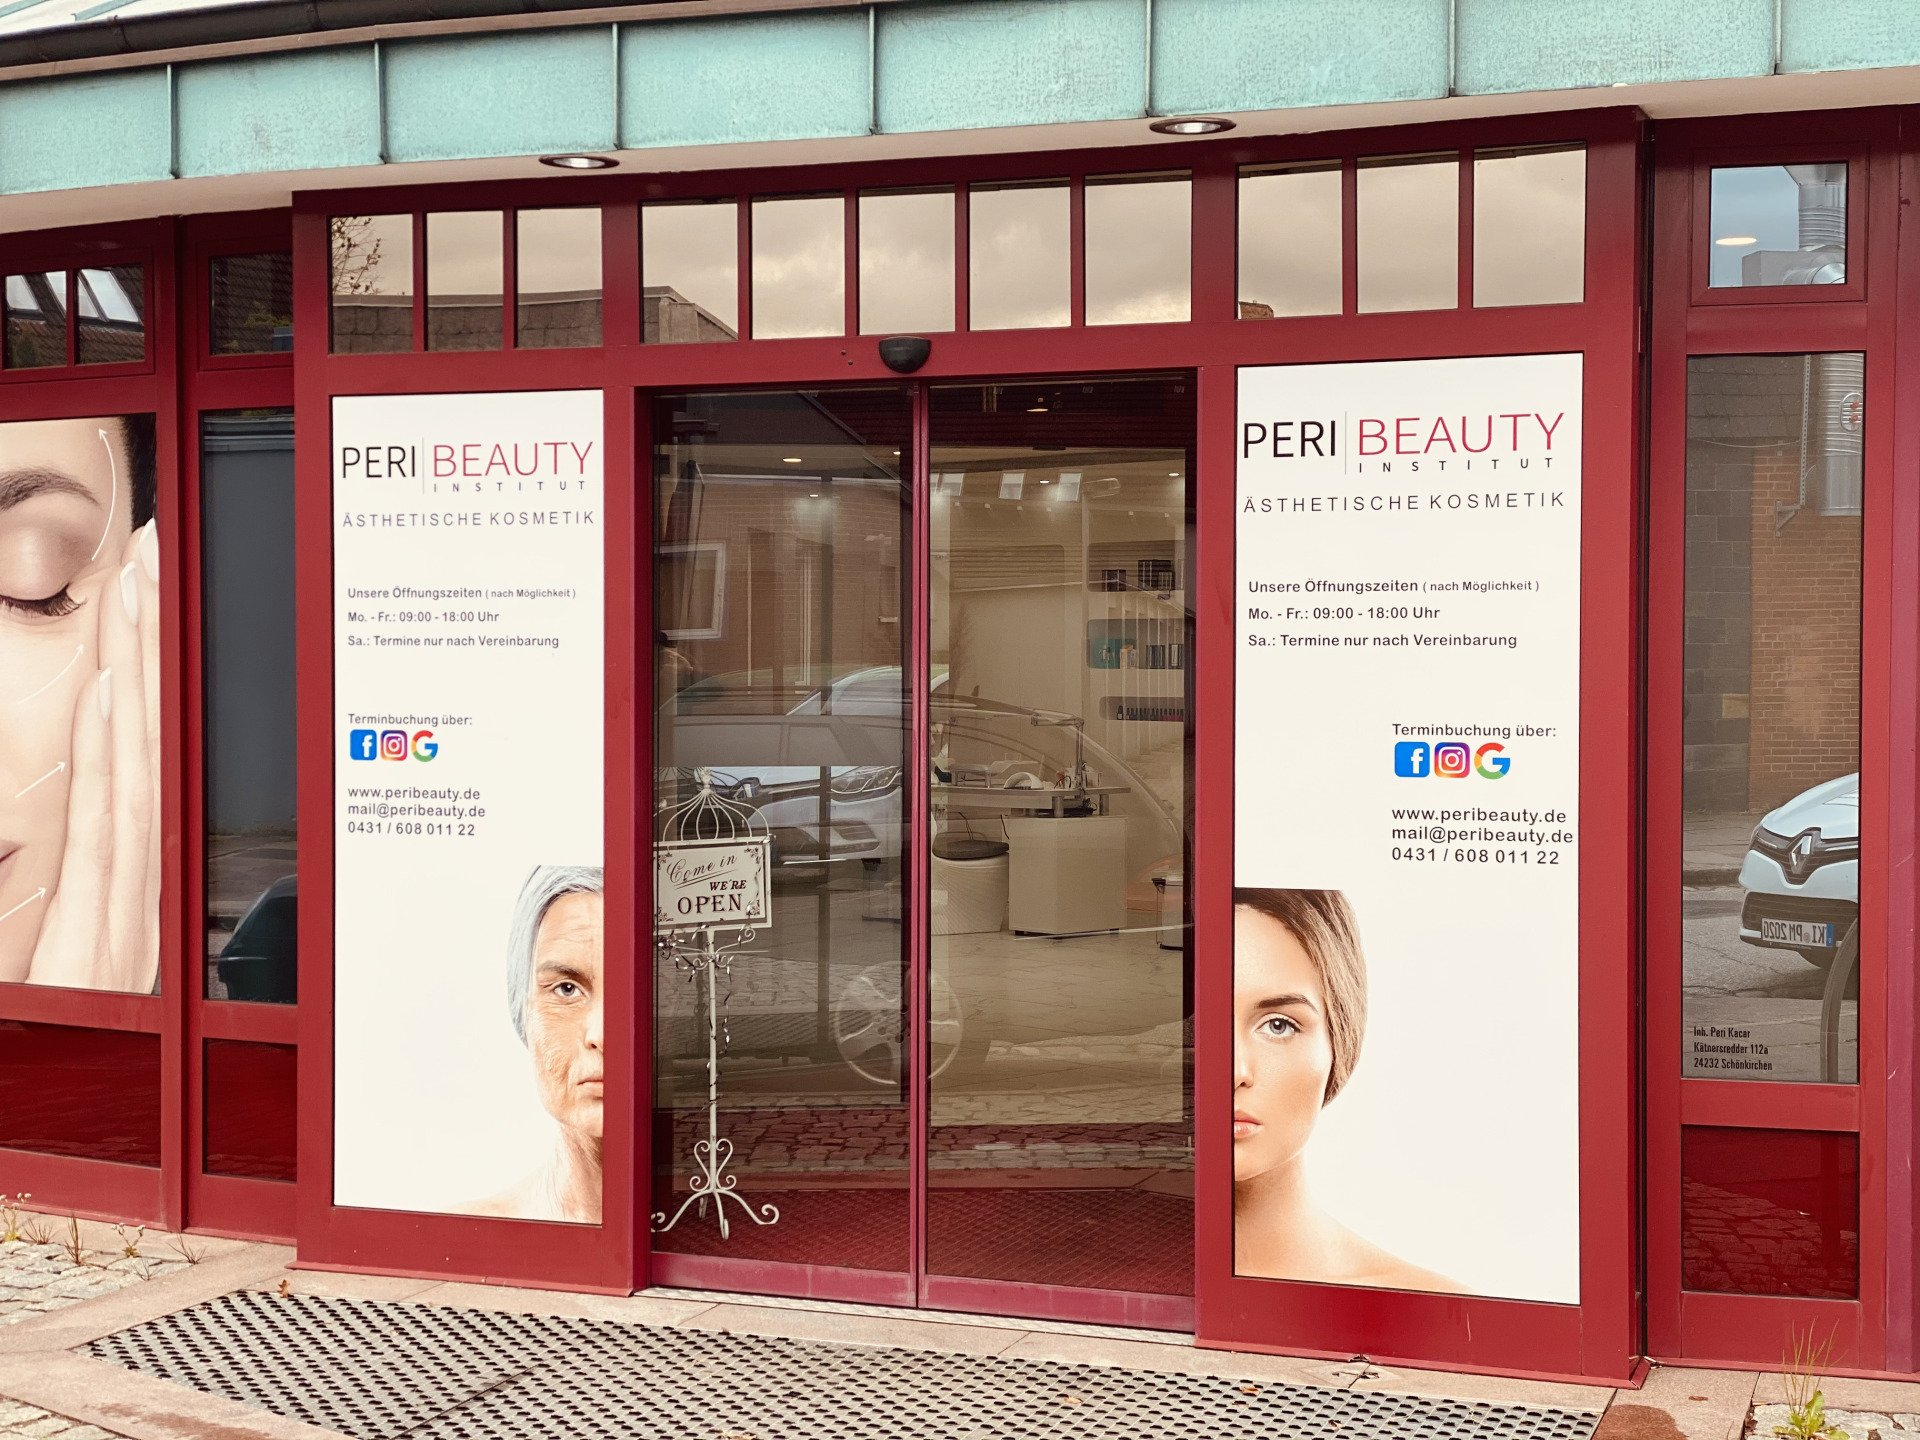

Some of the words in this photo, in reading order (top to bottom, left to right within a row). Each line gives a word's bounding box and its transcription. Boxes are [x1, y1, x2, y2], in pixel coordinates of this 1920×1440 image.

[1244, 420, 1335, 458] PERI
[1359, 413, 1564, 455] BEAUTY
[342, 446, 415, 478] PERI
[434, 442, 593, 477] BEAUTY
[1359, 458, 1552, 473] INSTITUT
[434, 481, 584, 492] INSTITUT
[1244, 496, 1419, 513] ÄSTHETISCHE
[1431, 492, 1564, 509] KOSMETIK
[343, 513, 481, 527] ÄSTHETISCHE
[490, 511, 593, 525] KOSMETIK
[348, 588, 389, 598] Unsere
[393, 586, 482, 600] Öffnungszeiten
[492, 589, 513, 597] nach
[517, 589, 570, 599] Möglichkeit
[1249, 581, 1300, 593] Unsere
[1305, 578, 1418, 594] Öffnungszeiten
[1430, 582, 1459, 591] nach
[1463, 581, 1532, 593] Möglichkeit
[348, 612, 367, 622] Mo.
[378, 612, 395, 622] Fr.:
[399, 612, 431, 622] 09:00
[443, 612, 474, 622] 18:00
[478, 612, 499, 622] Uhr
[1249, 609, 1273, 620] Mo.
[1287, 608, 1308, 619] Fr.:
[1313, 608, 1353, 619] 09:00
[1368, 607, 1408, 619] 18:00
[1413, 607, 1440, 618] Uhr
[348, 636, 370, 646] Sa.:
[374, 636, 420, 646] Termine
[424, 638, 443, 646] nur
[447, 636, 474, 646] nach
[479, 636, 559, 648] Vereinbarung
[1249, 635, 1276, 646] Sa.:
[1281, 635, 1339, 646] Termine
[1344, 637, 1368, 646] nur
[1373, 635, 1409, 646] nach
[1414, 635, 1517, 648] Vereinbarung
[348, 714, 438, 727] Terminbuchung
[442, 715, 472, 725] über:
[1393, 724, 1511, 739] Terminbuchung
[1516, 725, 1556, 737] über:
[348, 787, 480, 801] www.peribeauty.de
[348, 803, 485, 819] mail@peribeauty.de
[1392, 808, 1566, 825] www.peribeauty.de
[348, 822, 382, 834] 0431
[396, 823, 422, 834] 608
[427, 823, 451, 835] 011
[458, 824, 475, 836] 22
[1392, 827, 1573, 845] mail@peribeauty.de
[1392, 847, 1436, 861] 0431
[1455, 849, 1488, 862] 608
[1496, 850, 1528, 863] 011
[1537, 851, 1559, 864] 22
[667, 859, 715, 883] Come
[720, 855, 737, 867] in
[710, 880, 746, 890] WE'RE
[678, 894, 743, 914] OPEN
[1694, 1027, 1708, 1037] Inh.
[1711, 1027, 1725, 1037] Peri
[1729, 1028, 1750, 1038] Kacar
[1694, 1042, 1748, 1054] Kätnersredder
[1751, 1044, 1768, 1054] 112a
[1694, 1058, 1719, 1068] 24232
[1722, 1059, 1772, 1070] Schönkirchen
